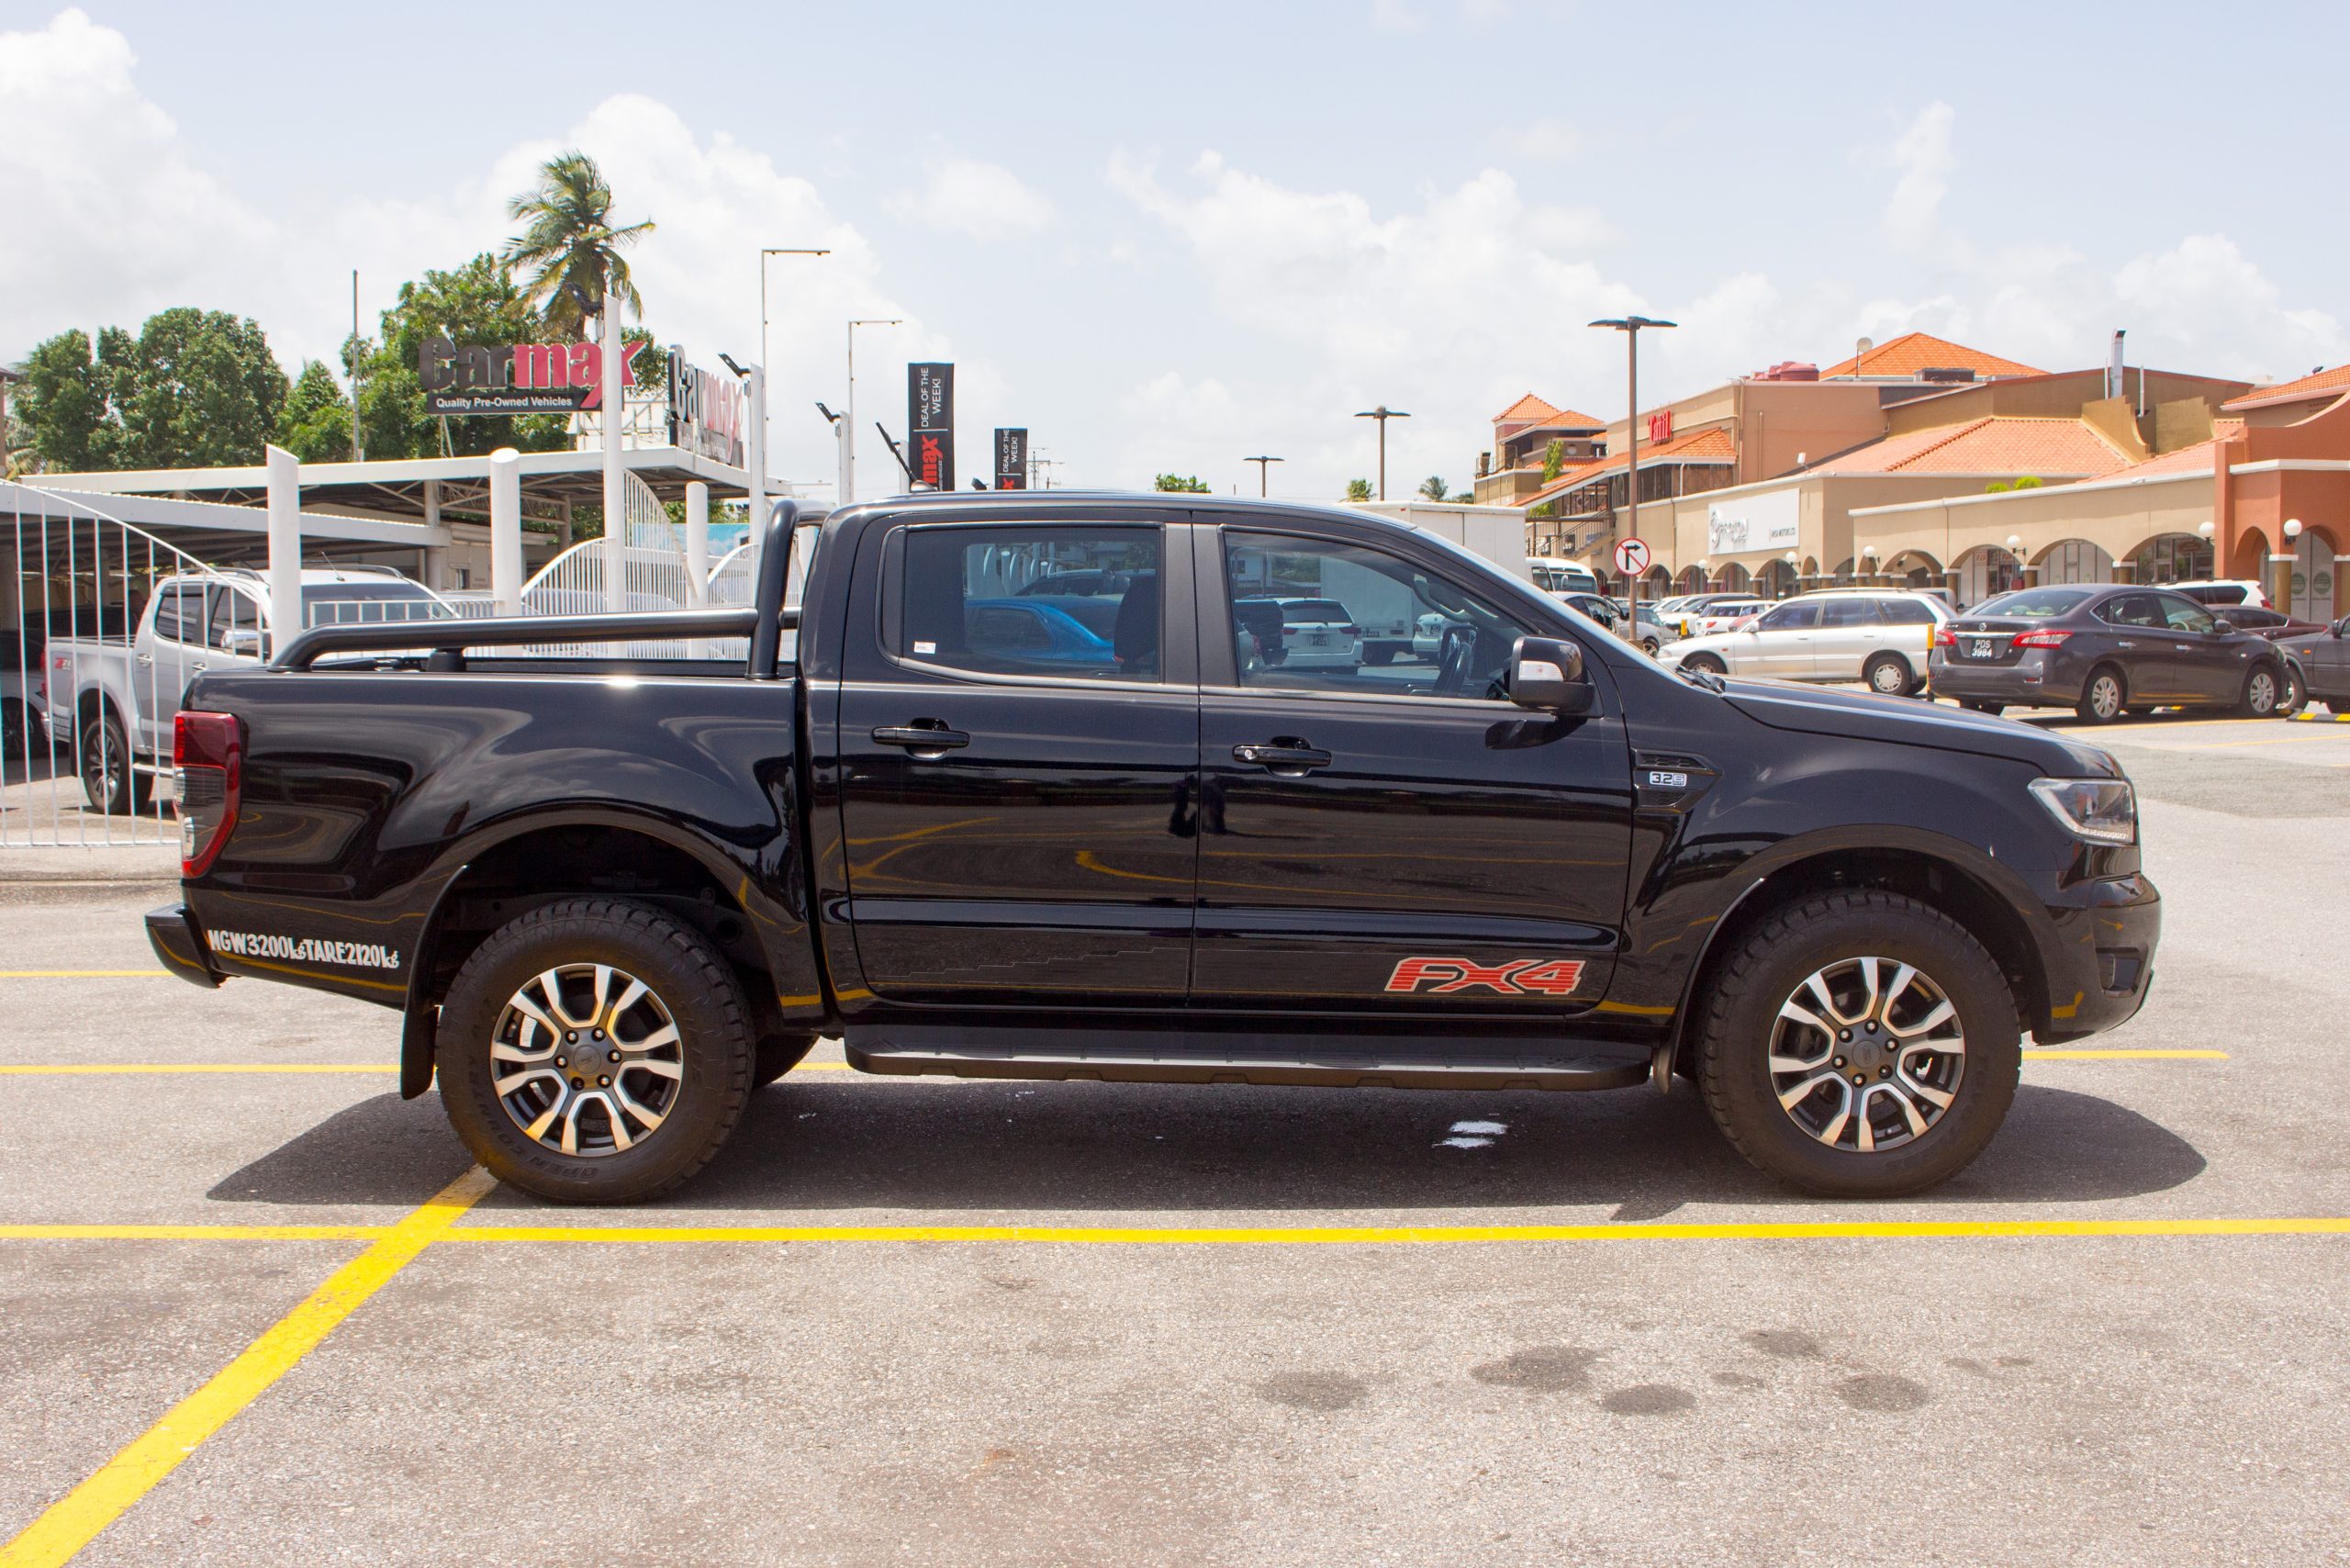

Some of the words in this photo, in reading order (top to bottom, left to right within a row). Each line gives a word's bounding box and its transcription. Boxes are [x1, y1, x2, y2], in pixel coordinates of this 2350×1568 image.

[419, 337, 647, 409] Carmax
[921, 367, 929, 386] THE
[921, 387, 929, 401] OF
[932, 378, 941, 414] WEEK!
[436, 398, 472, 409] Quality
[475, 397, 529, 408] Pre-Owned
[532, 397, 573, 407] Vehicles
[921, 402, 929, 428] DEAL
[1002, 443, 1010, 454] OF
[1975, 639, 1991, 648] PDS
[1971, 648, 1993, 657] 3984
[1651, 773, 1673, 785] 3.2
[1383, 957, 1586, 995] FX4
